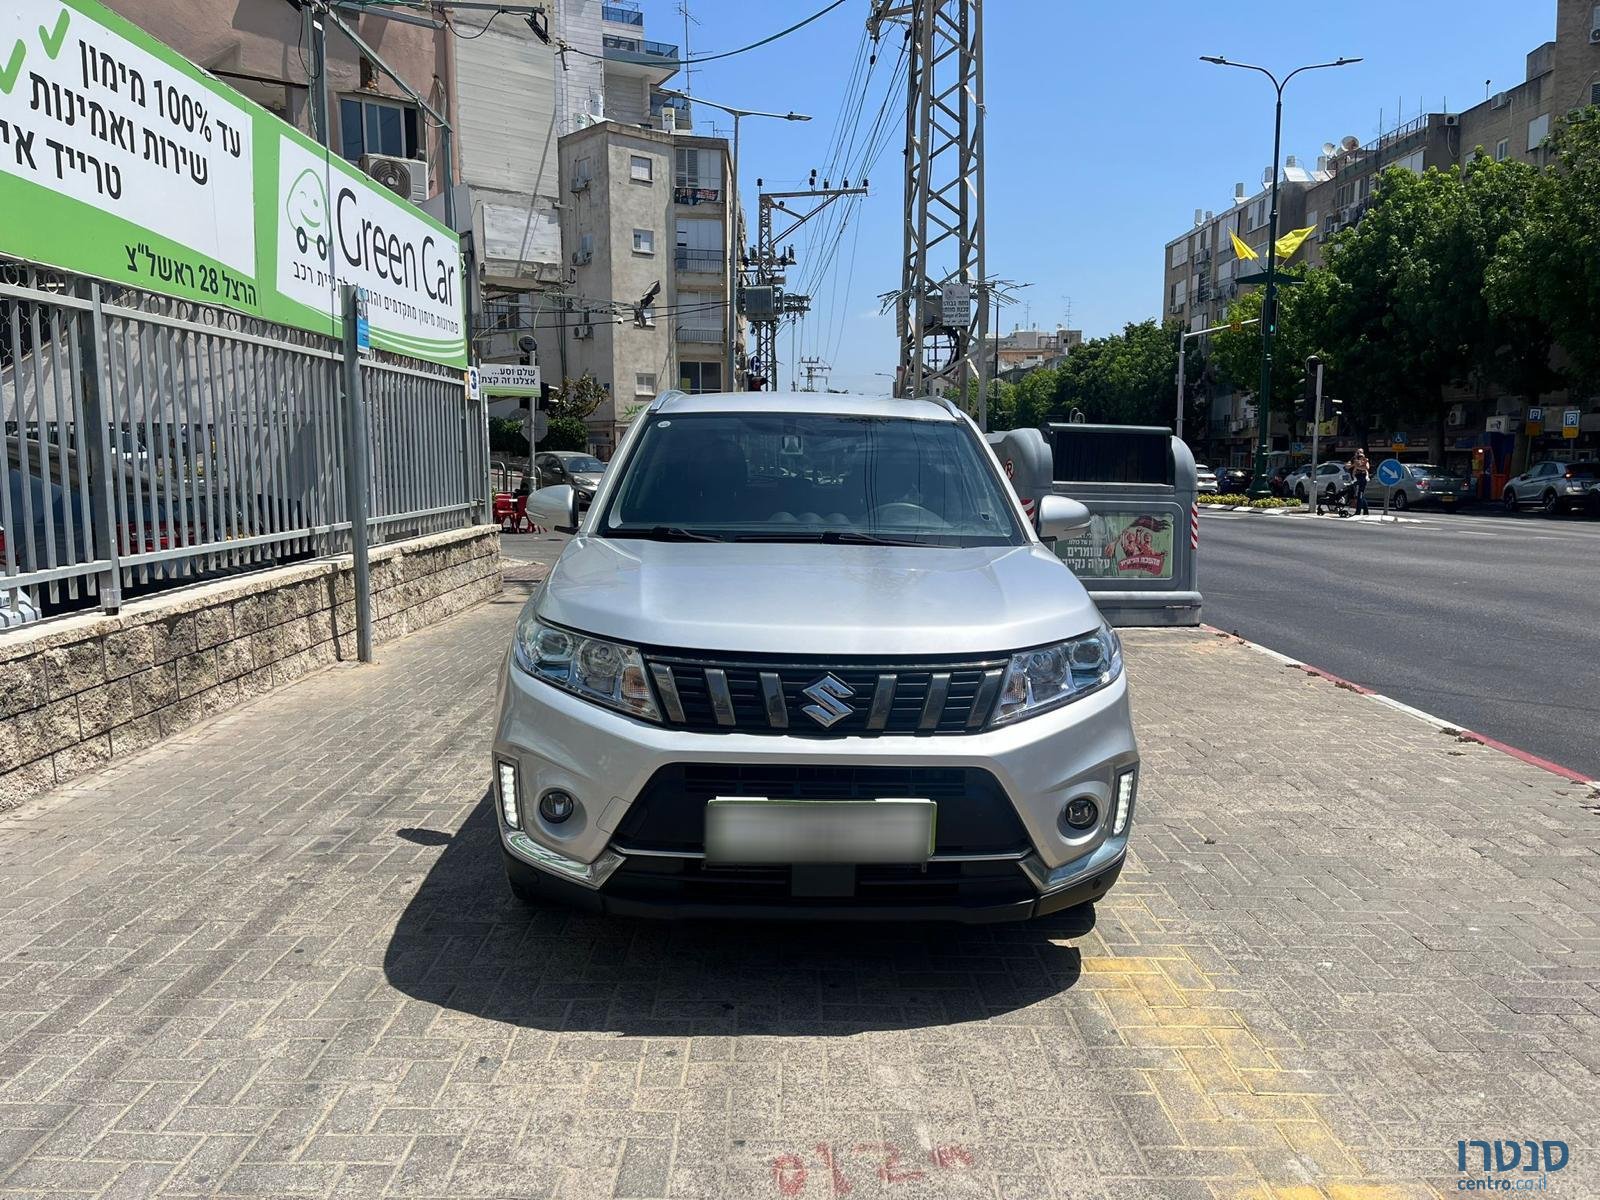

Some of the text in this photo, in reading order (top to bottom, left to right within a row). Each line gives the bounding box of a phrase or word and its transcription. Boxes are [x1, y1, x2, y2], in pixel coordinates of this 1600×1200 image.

[79, 39, 240, 158] עד 100% מימון
[29, 71, 208, 186] שירות ואמינות
[46, 138, 122, 200] טרייד
[337, 187, 454, 307] Green Car
[199, 264, 219, 295] 28
[293, 261, 314, 283] רכב
[221, 270, 257, 306] הרצל
[384, 296, 417, 320] מתקדמים
[418, 308, 435, 326] מימון
[481, 376, 536, 386] אצלנו זה קצת
[517, 367, 536, 377] שלם
[1067, 547, 1102, 557] שומרים
